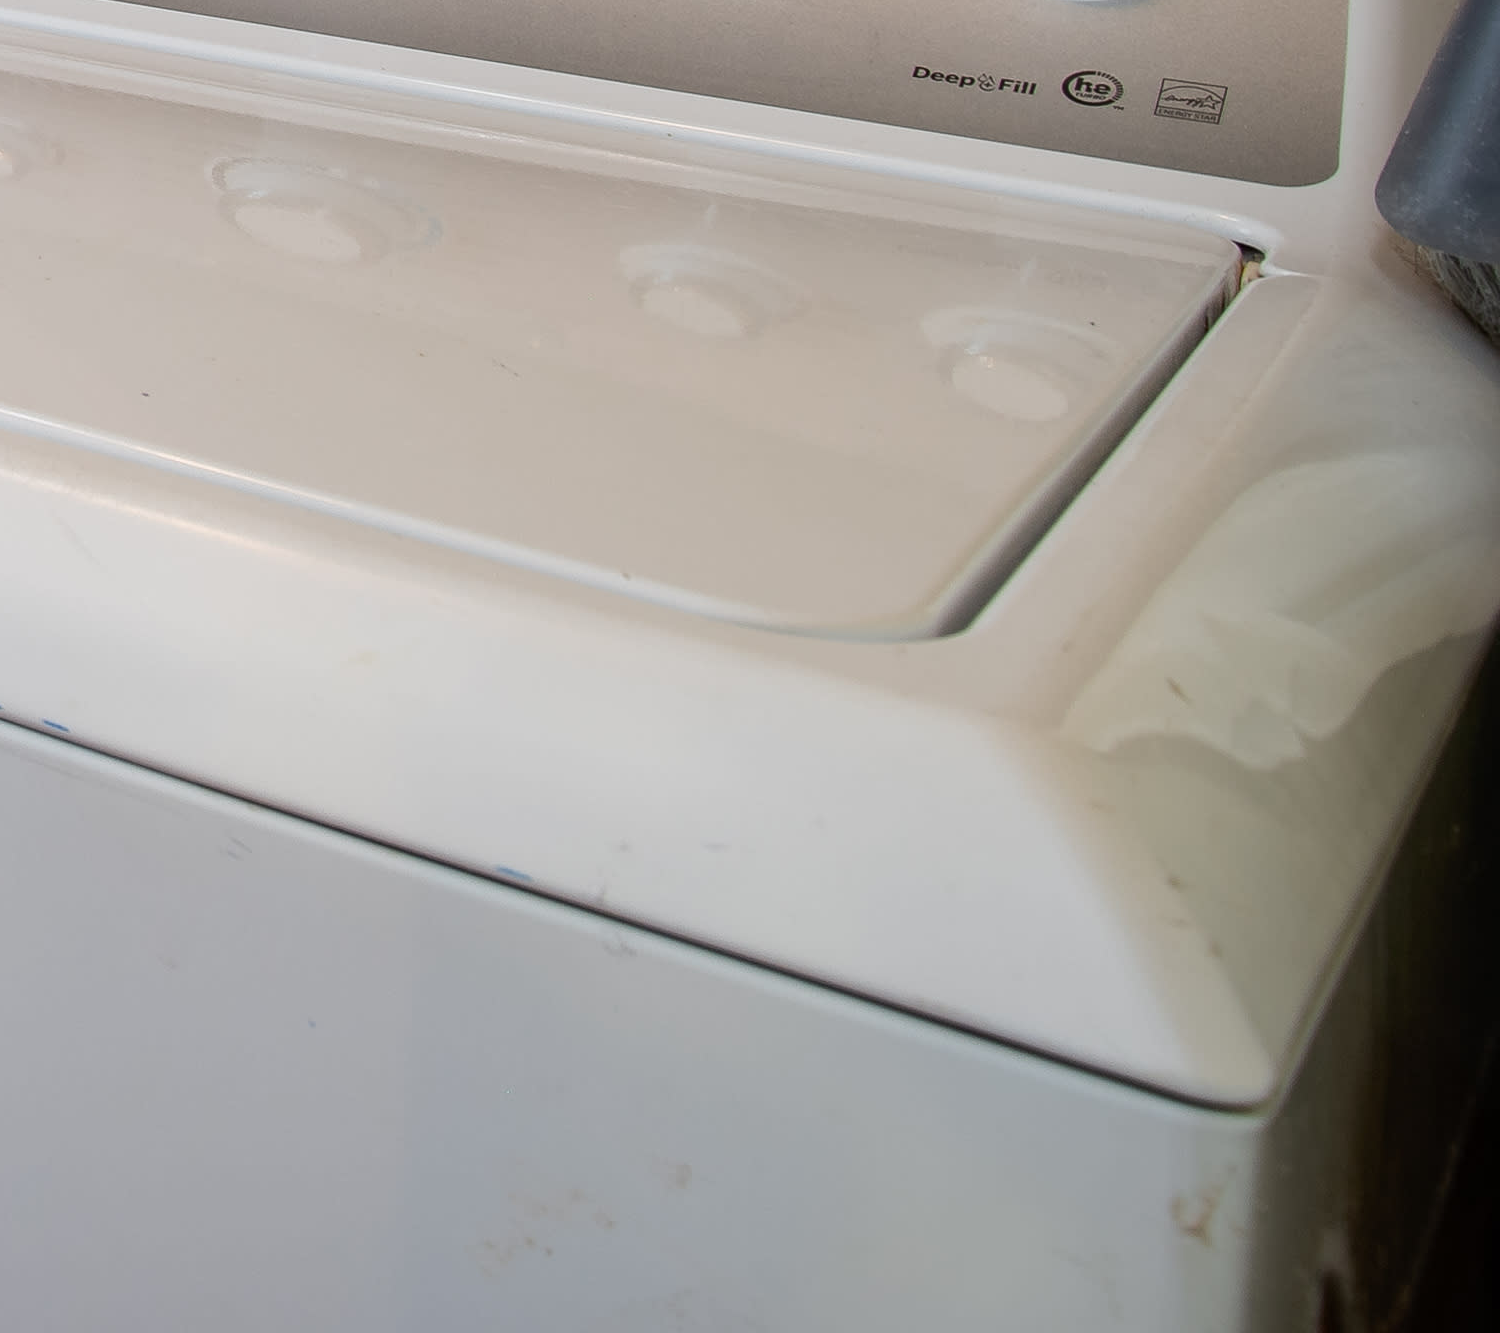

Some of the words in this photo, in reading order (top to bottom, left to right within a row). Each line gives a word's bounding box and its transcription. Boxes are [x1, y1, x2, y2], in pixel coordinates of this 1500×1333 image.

[911, 65, 977, 89] Deep
[997, 77, 1038, 95] Fill
[1158, 108, 1192, 119] ENERGY
[1193, 112, 1217, 123] STAR
